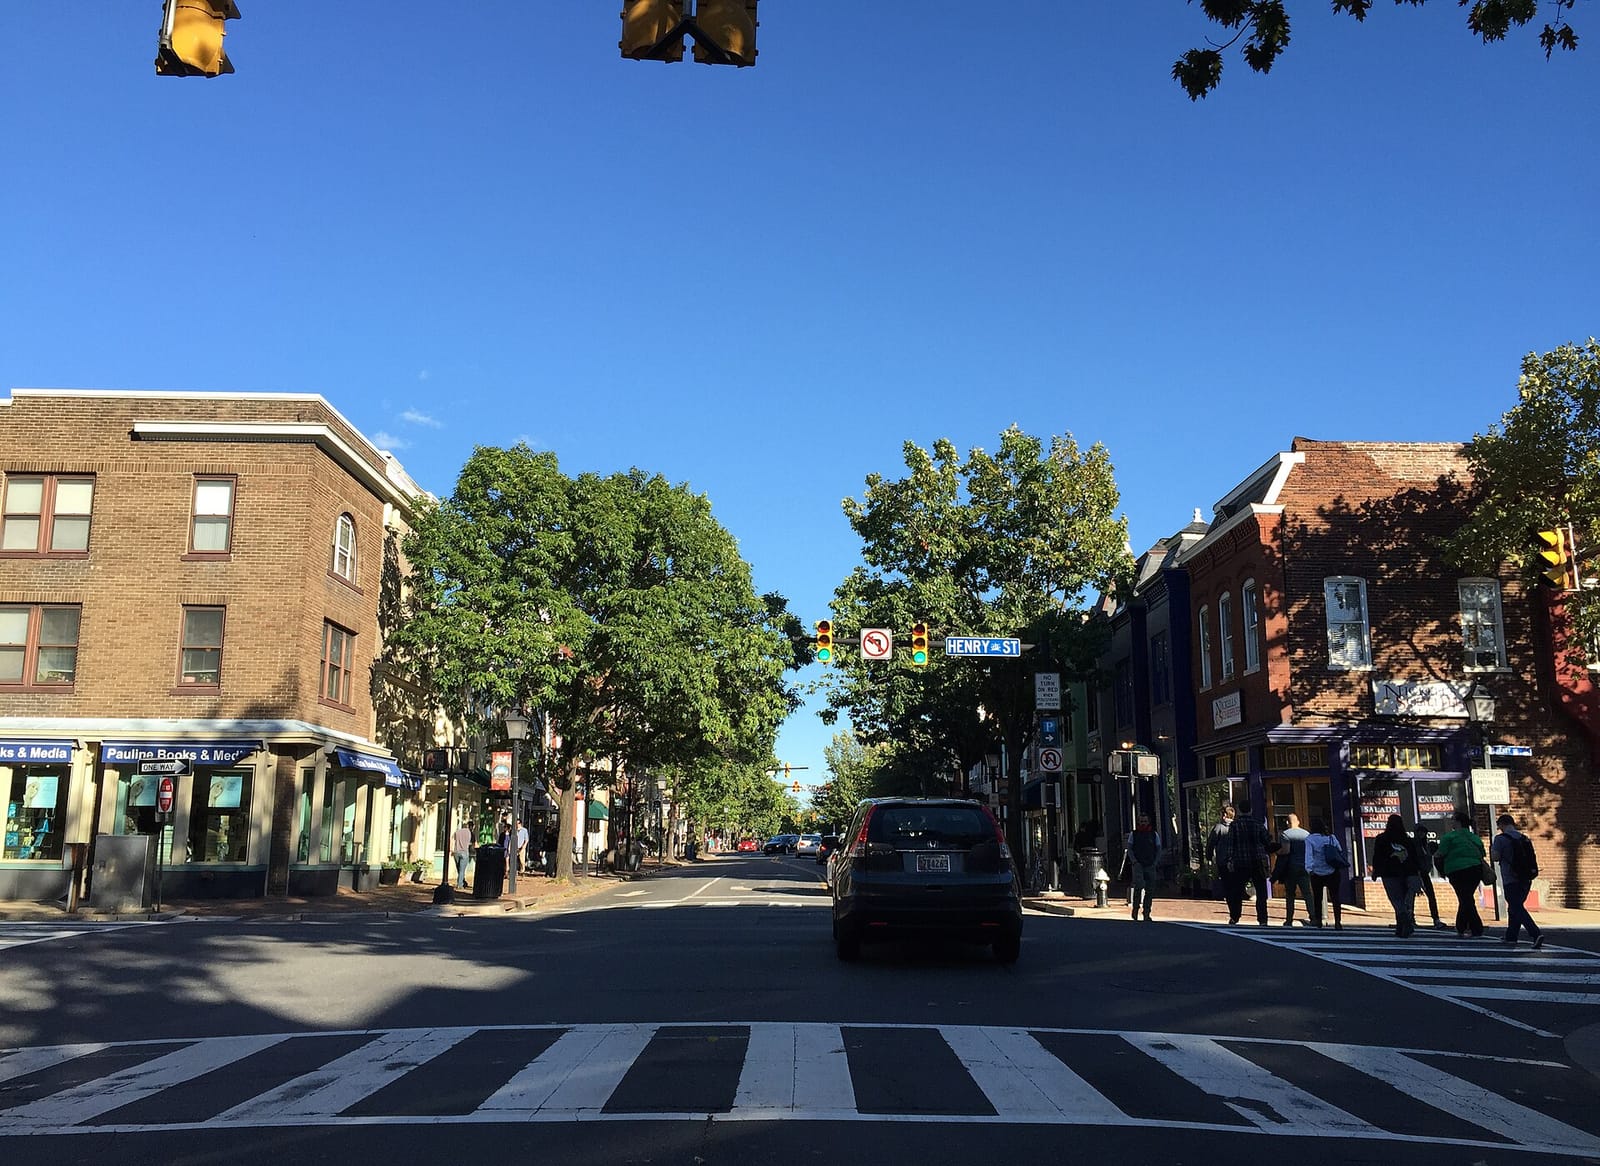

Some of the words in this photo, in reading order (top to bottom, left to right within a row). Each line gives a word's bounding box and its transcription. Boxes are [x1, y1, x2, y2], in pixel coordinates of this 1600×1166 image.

[948, 640, 990, 653] HENRY
[1002, 640, 1018, 654] ST
[1046, 721, 1053, 732] P
[17, 747, 27, 758] &
[30, 747, 67, 758] Media
[107, 748, 154, 760] Pauline
[157, 749, 197, 760] Books
[200, 750, 210, 760] &
